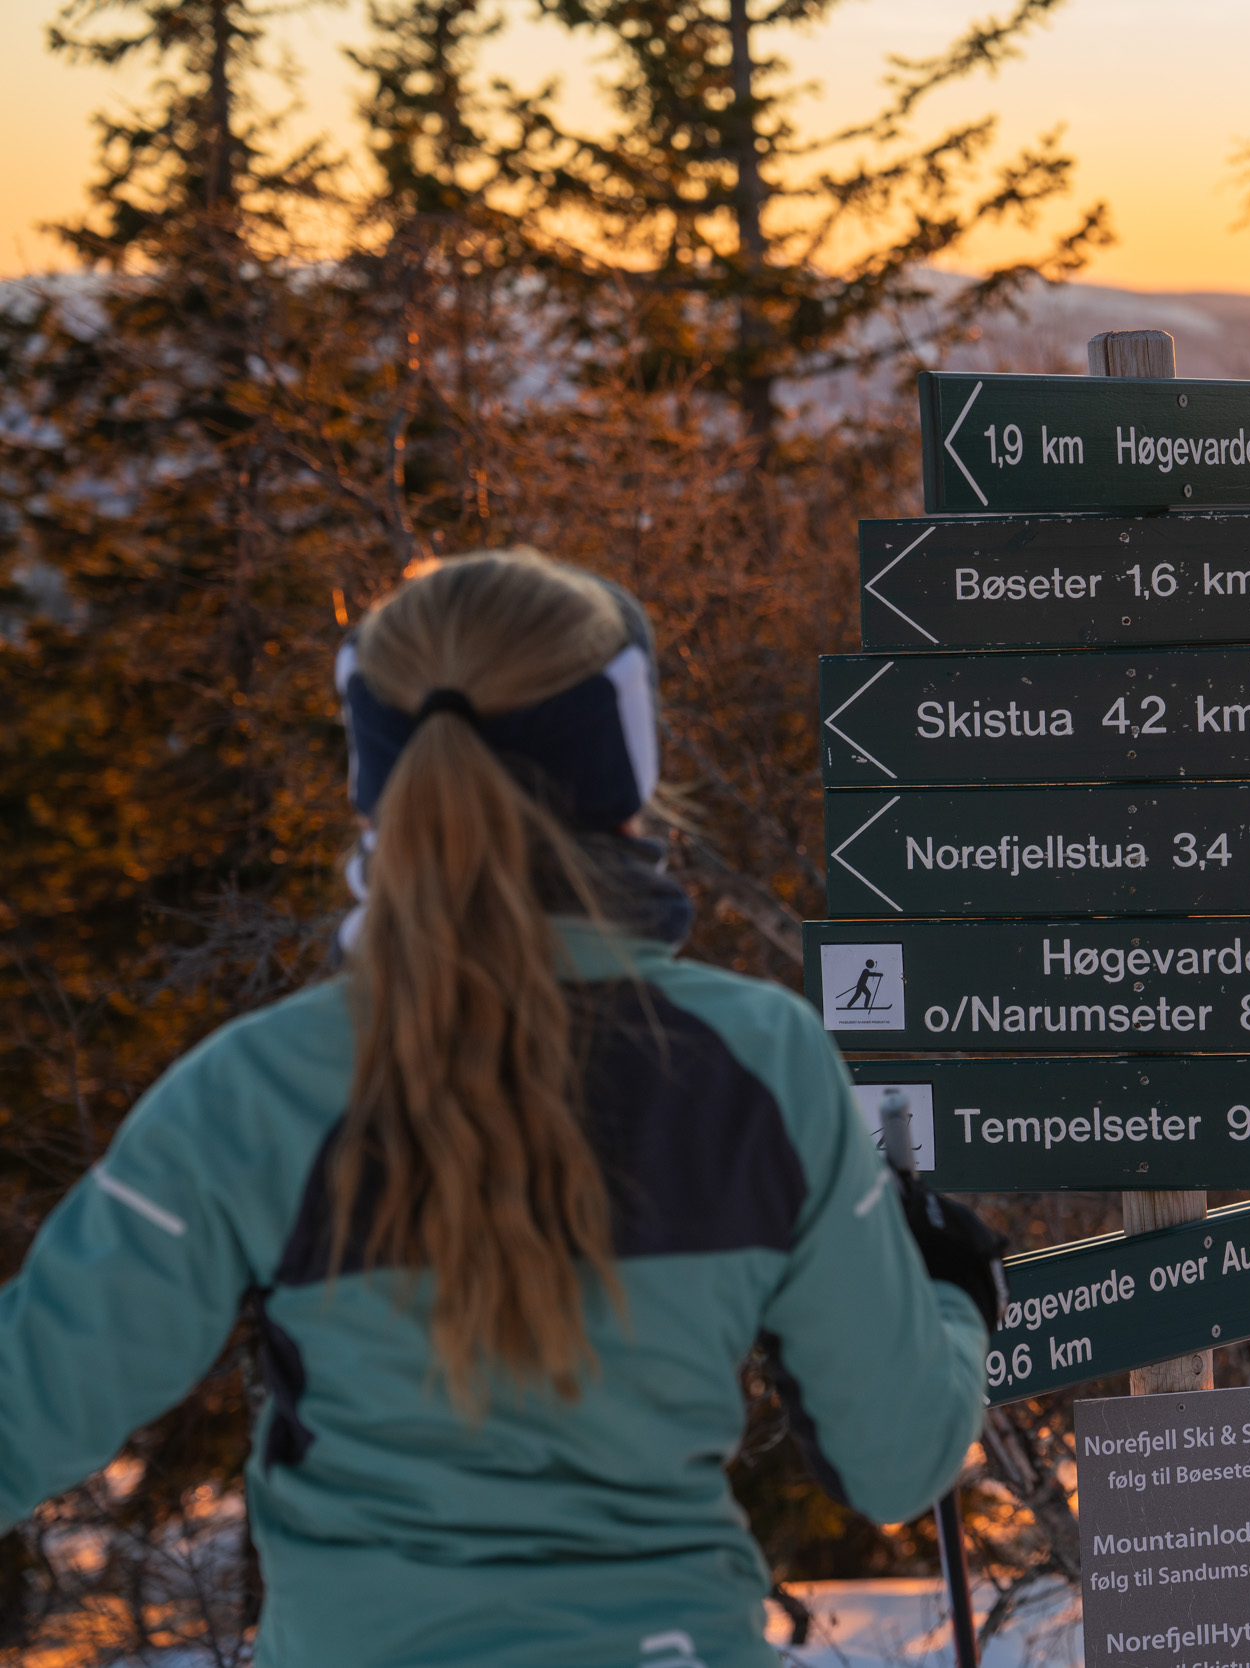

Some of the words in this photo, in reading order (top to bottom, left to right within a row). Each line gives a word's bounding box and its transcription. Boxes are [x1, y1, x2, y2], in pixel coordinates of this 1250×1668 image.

[983, 423, 1024, 466] 1,9
[1041, 424, 1084, 464] km
[955, 567, 1103, 601] Bøseter
[1126, 562, 1179, 597] 1,6
[917, 700, 1074, 739] Skistua
[1101, 695, 1167, 735] 4,2
[906, 834, 1149, 877] Norefjellstua
[1172, 832, 1233, 871] 3,4
[924, 995, 1213, 1033] o/Narumseter
[953, 1106, 1202, 1150] Tempelseter
[996, 1268, 1136, 1332] øgevarde
[1149, 1255, 1208, 1292] over
[985, 1342, 1033, 1388] 9,6
[1049, 1336, 1093, 1371] km
[1084, 1428, 1177, 1458] Norefjell
[1183, 1426, 1215, 1449] Ski
[1220, 1424, 1237, 1446] &
[1107, 1469, 1147, 1492] følg
[1151, 1466, 1171, 1486] til
[1090, 1570, 1129, 1593] følg
[1134, 1567, 1153, 1587] til
